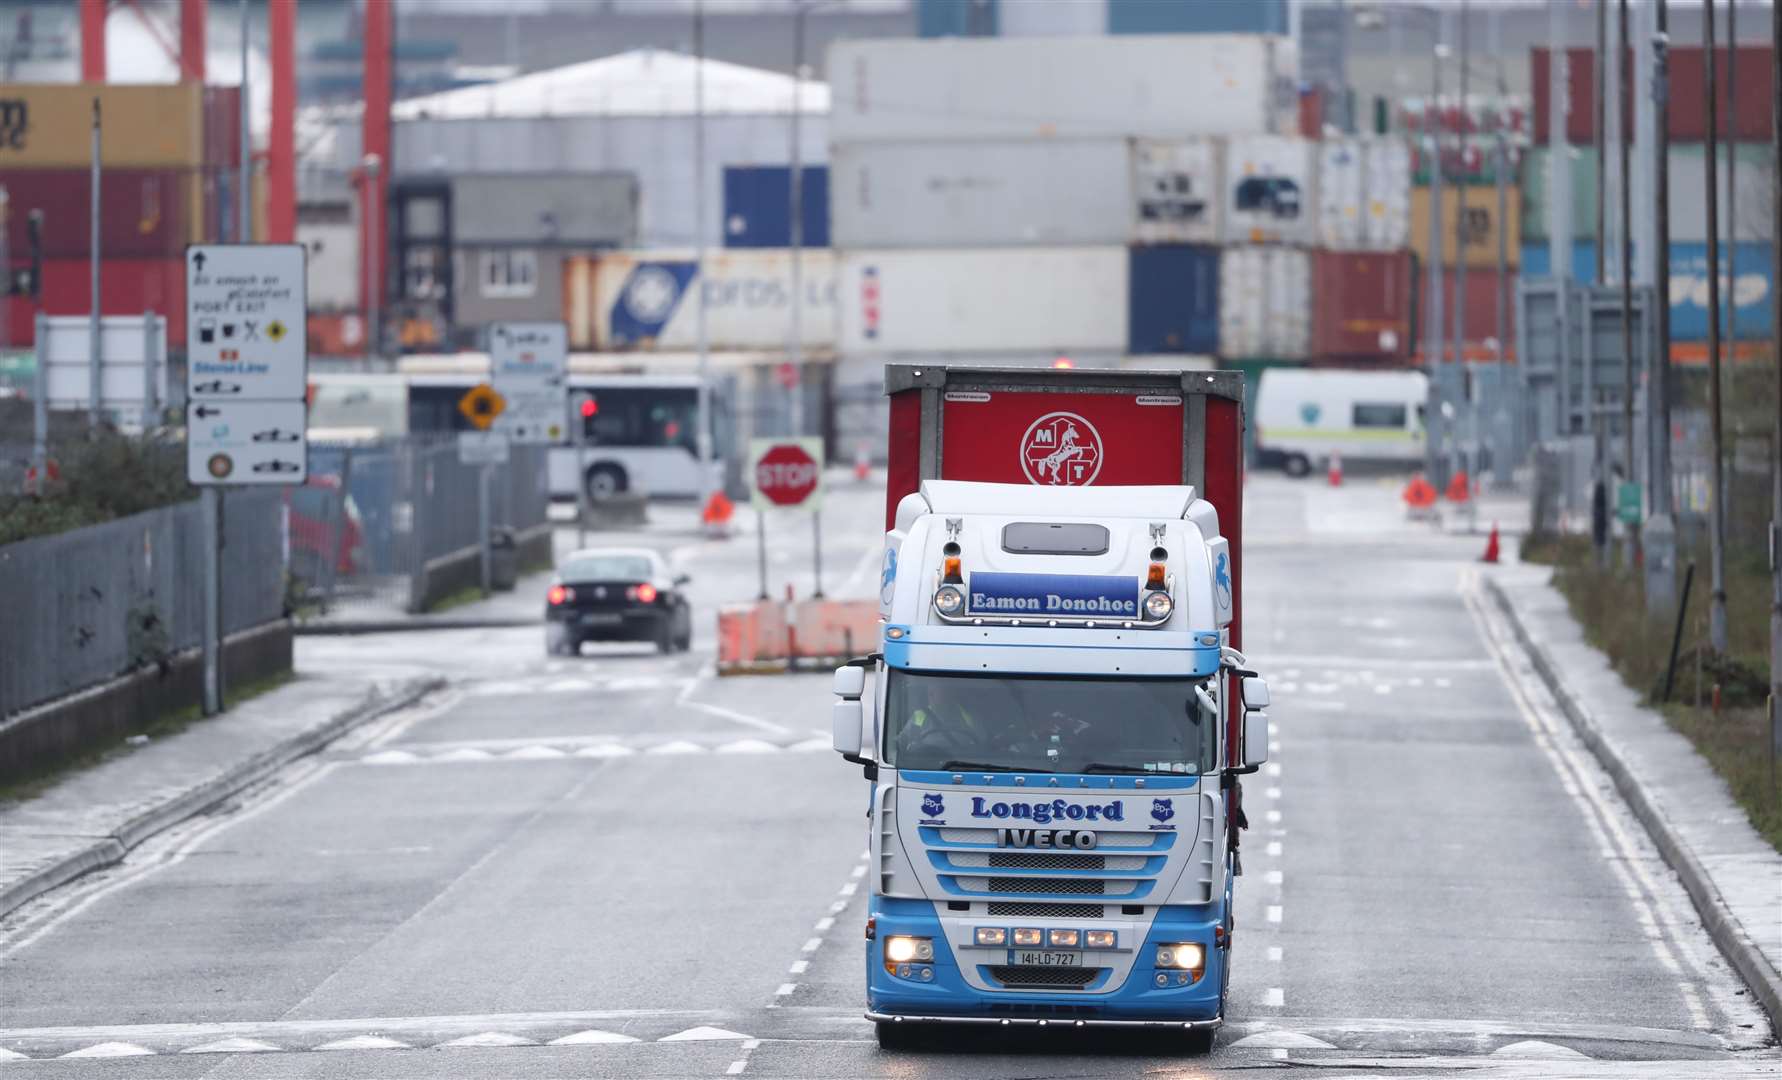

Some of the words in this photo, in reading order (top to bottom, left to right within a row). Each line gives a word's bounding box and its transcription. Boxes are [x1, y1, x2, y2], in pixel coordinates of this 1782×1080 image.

[194, 301, 230, 312] PORT
[1036, 429, 1053, 442] M
[757, 463, 817, 488] STOP
[1074, 465, 1084, 479] T
[972, 593, 1040, 609] Eamon
[1046, 594, 1135, 612] Donohoe
[971, 796, 1125, 824] Longford
[997, 828, 1097, 850] IVECO
[1022, 953, 1074, 965] 141-LD-727
